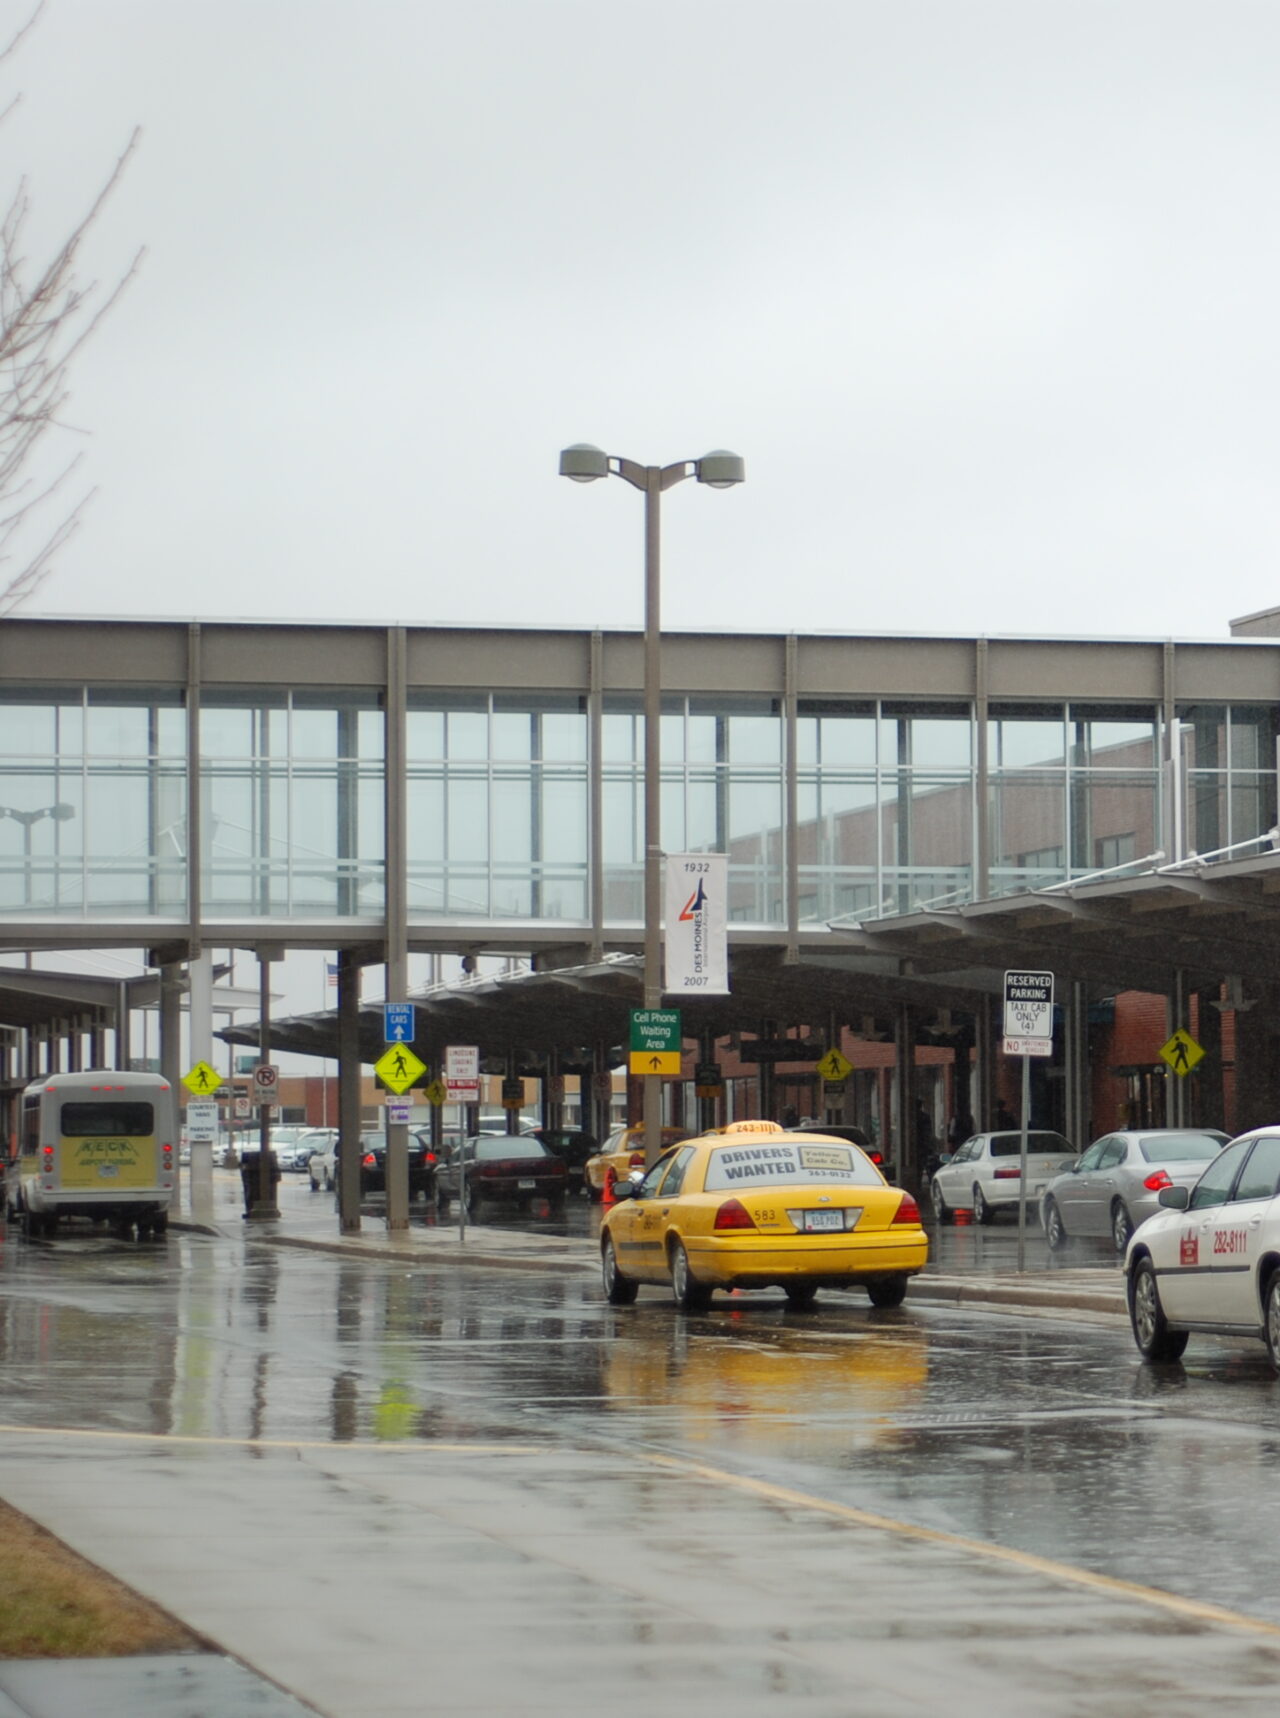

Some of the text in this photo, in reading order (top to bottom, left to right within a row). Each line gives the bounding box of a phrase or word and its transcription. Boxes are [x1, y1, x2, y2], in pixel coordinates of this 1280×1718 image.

[684, 863, 710, 873] 1932
[694, 912, 703, 973] DES MOINES
[684, 976, 709, 986] 2007
[1007, 975, 1052, 987] RESERVED
[1010, 988, 1047, 999] PARKING
[1011, 1002, 1047, 1013] TAXI CAB
[390, 1015, 408, 1024] CARS
[633, 1012, 677, 1023] Cell Phone
[1015, 1012, 1040, 1022] ONLY
[640, 1026, 671, 1038] Waiting
[1021, 1022, 1035, 1031] (4)
[646, 1040, 665, 1048] Area
[1006, 1041, 1020, 1052] NO
[736, 1123, 777, 1133] 243-1111
[720, 1147, 794, 1166] DRIVERS
[804, 1150, 841, 1158] Yellow
[724, 1161, 797, 1181] WANTED
[754, 1209, 776, 1221] 583
[1213, 1229, 1247, 1254] 282-8111
